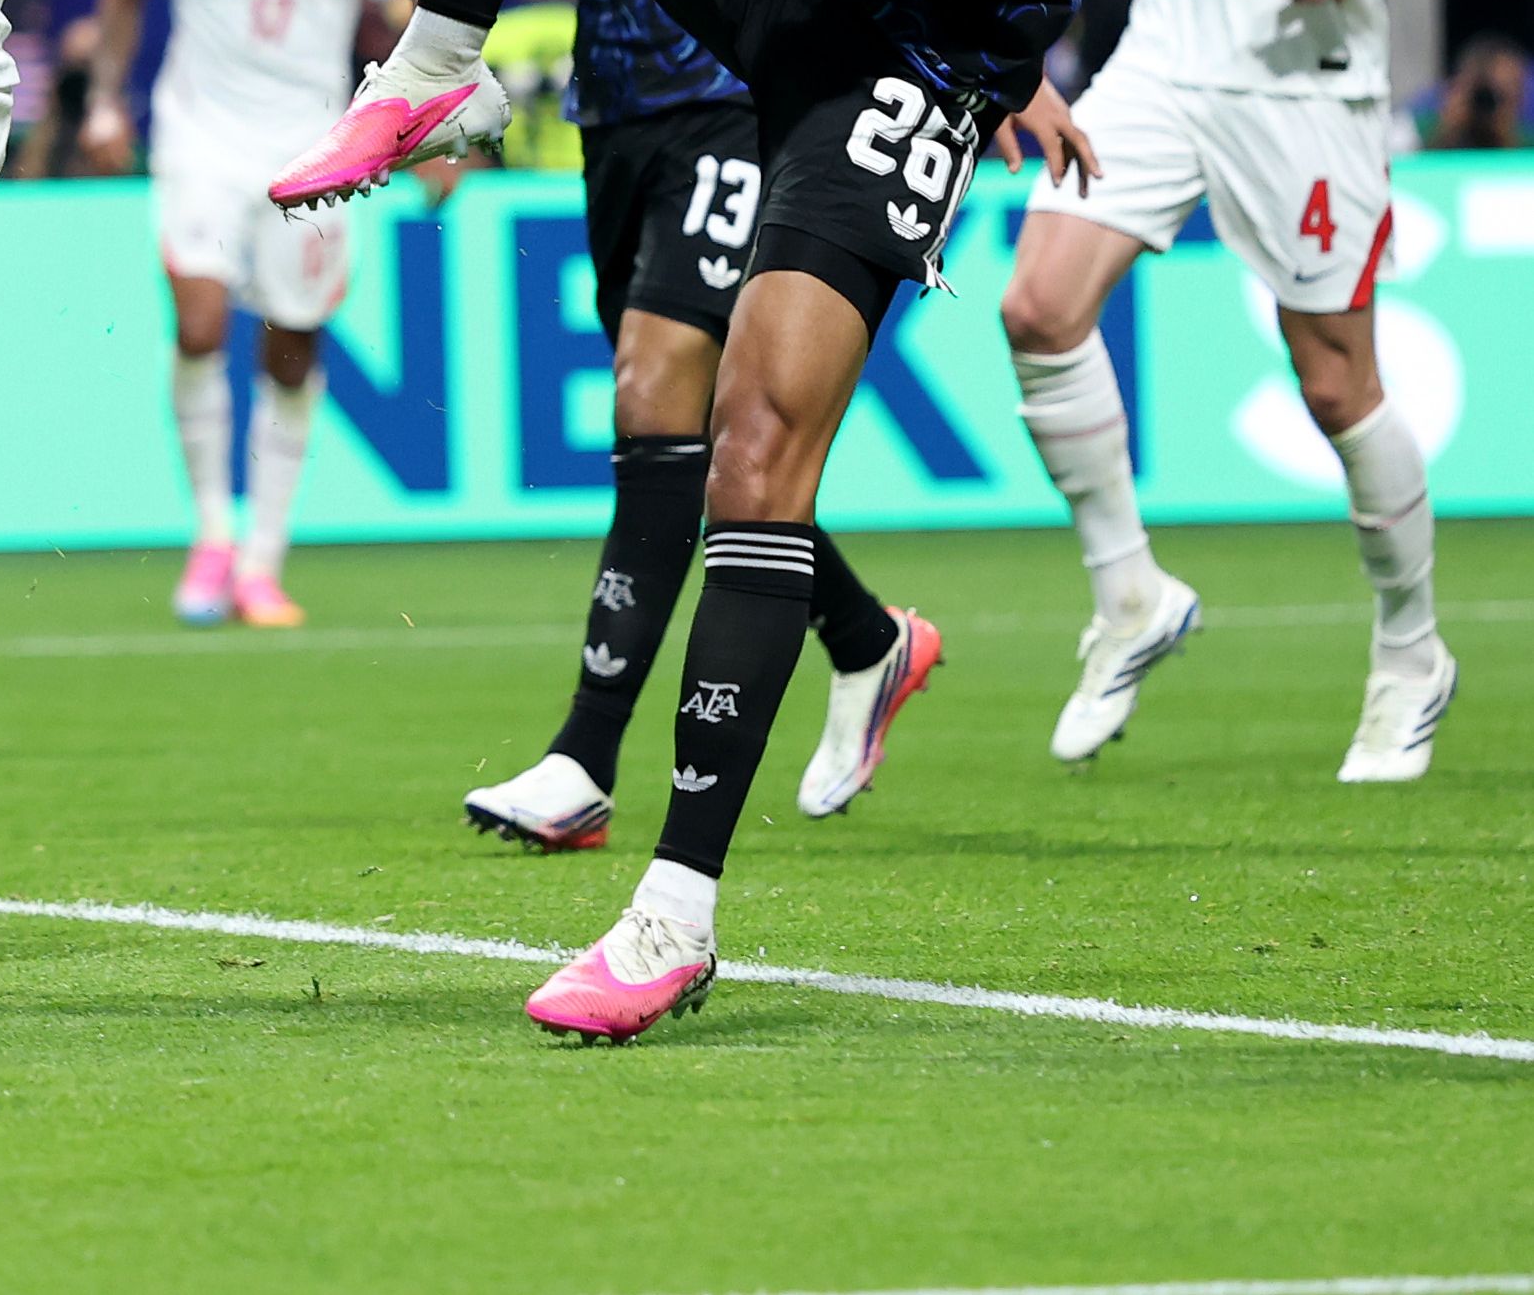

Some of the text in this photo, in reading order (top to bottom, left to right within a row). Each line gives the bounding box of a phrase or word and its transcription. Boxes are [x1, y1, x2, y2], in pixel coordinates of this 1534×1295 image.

[845, 76, 954, 204] 26
[682, 154, 763, 251] 13
[1298, 179, 1336, 255] 4
[1230, 180, 1534, 492] S
[680, 679, 742, 725] AFA
